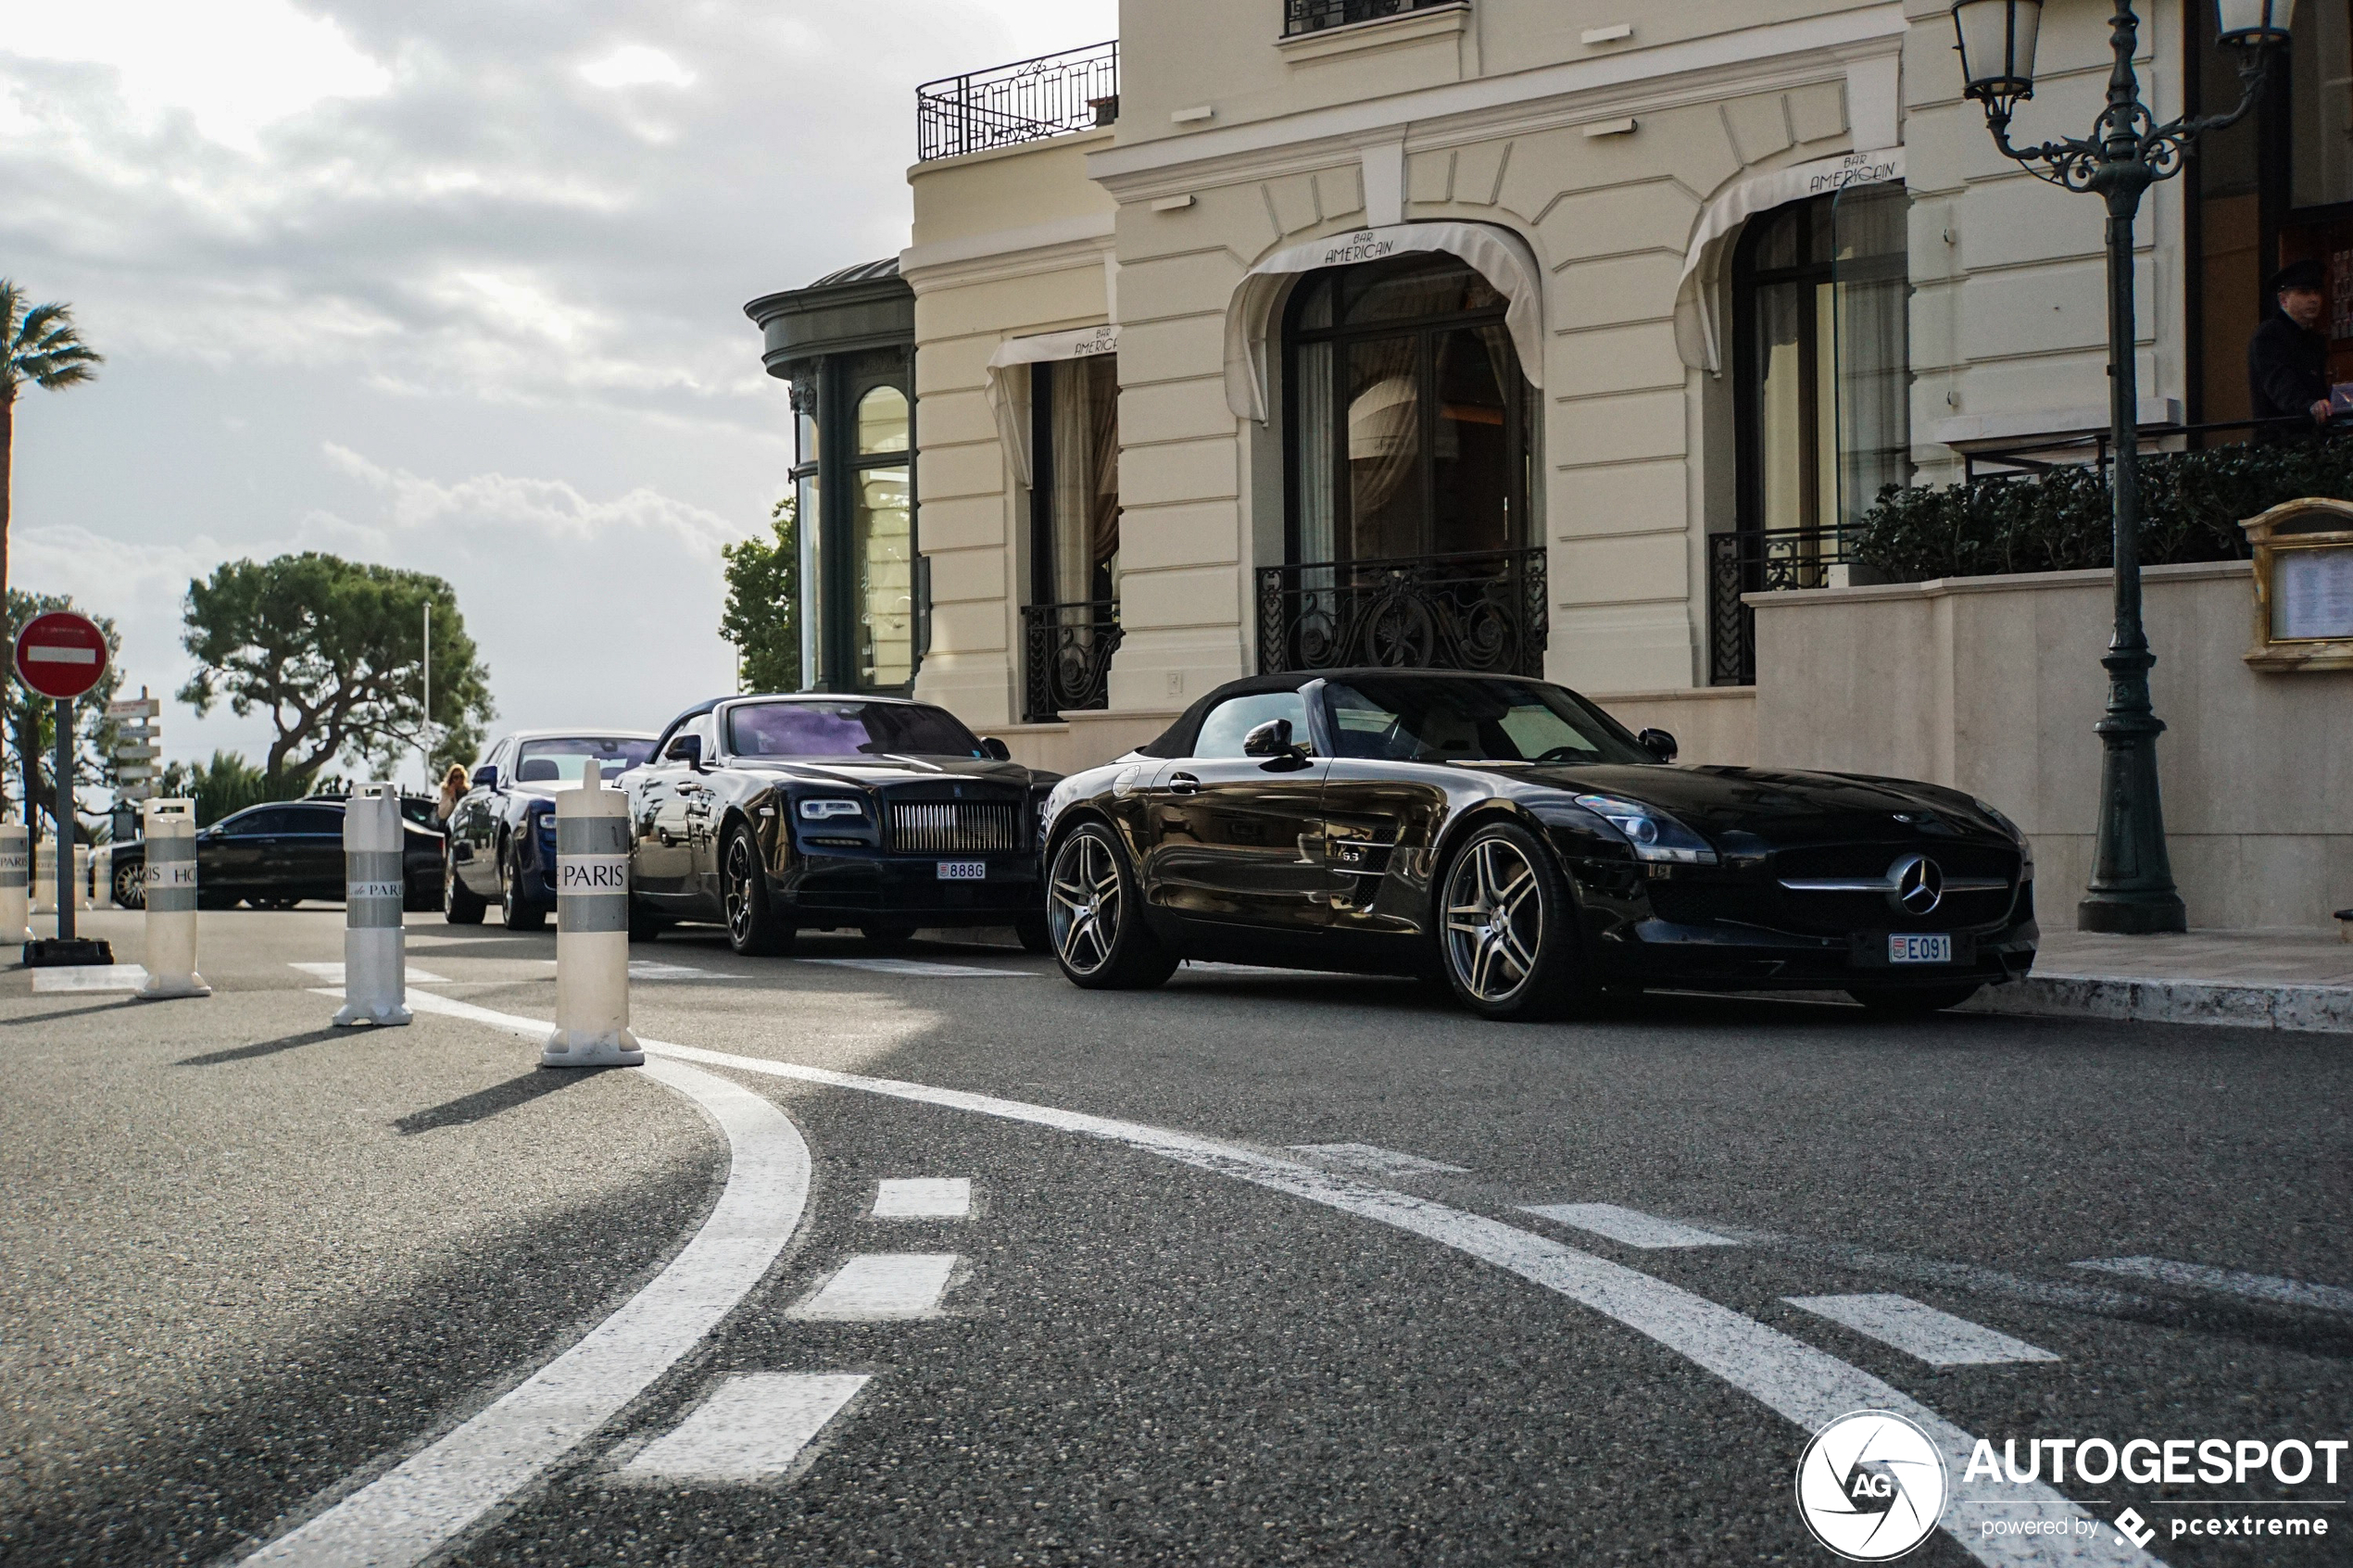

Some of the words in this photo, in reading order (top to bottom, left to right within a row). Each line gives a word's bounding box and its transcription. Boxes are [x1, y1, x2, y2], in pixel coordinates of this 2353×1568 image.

[1843, 155, 1868, 169] BAR
[1810, 162, 1895, 193] AMERICAIN
[1353, 232, 1374, 245] BAR
[1325, 241, 1394, 264] AMERICAIN
[1096, 328, 1112, 339] BAR
[564, 865, 623, 886] PARIS
[950, 864, 984, 877] 888G
[1908, 938, 1948, 960] E091
